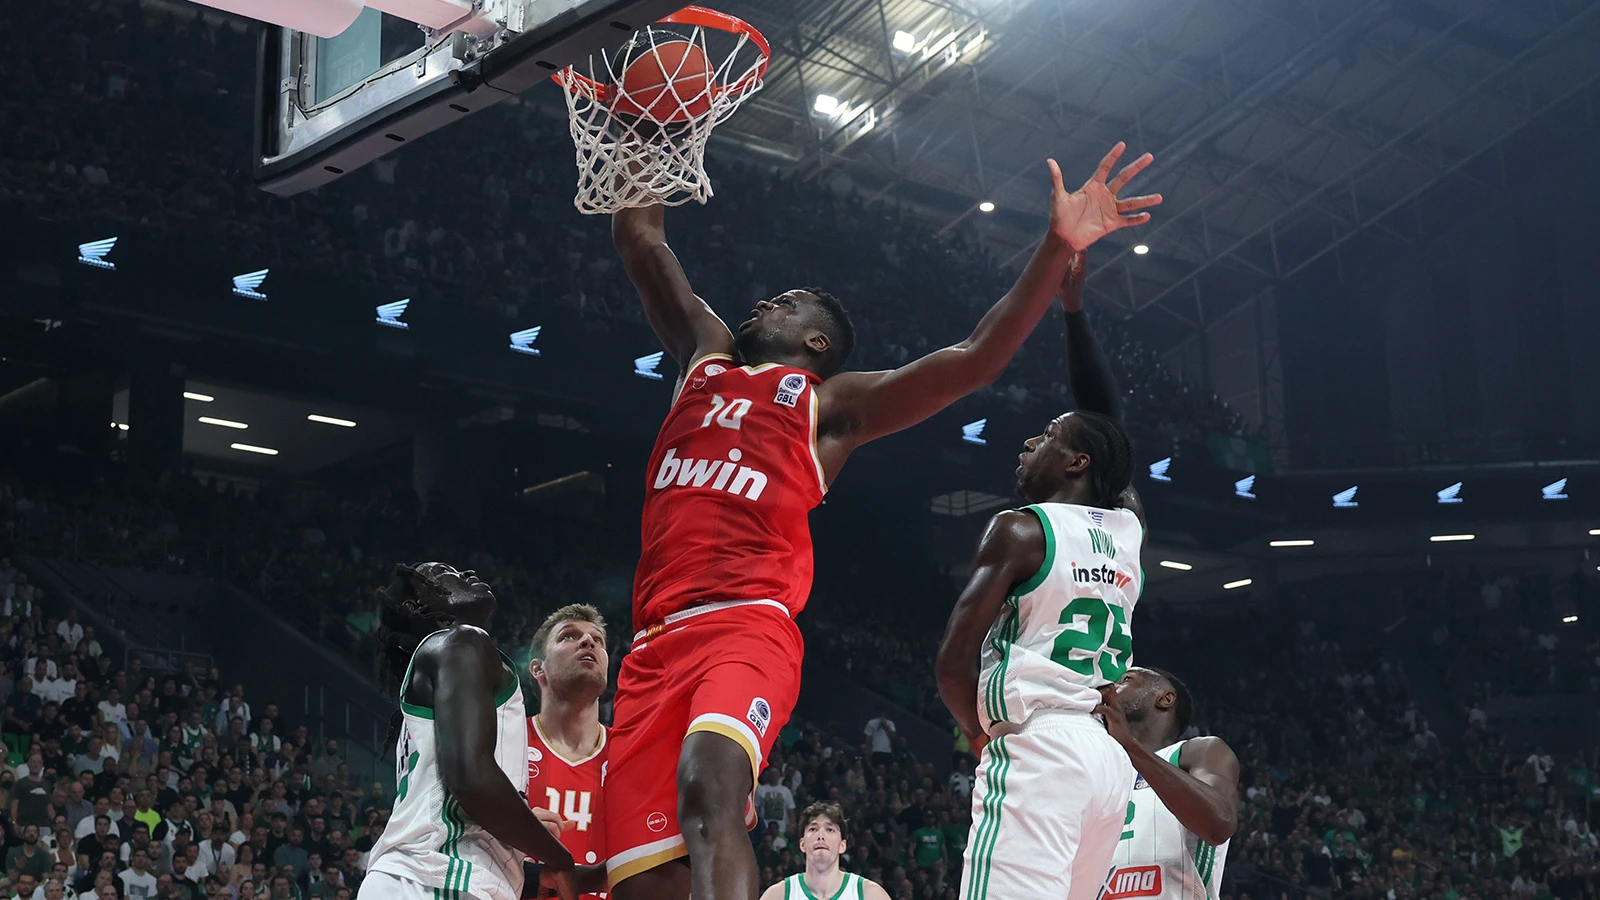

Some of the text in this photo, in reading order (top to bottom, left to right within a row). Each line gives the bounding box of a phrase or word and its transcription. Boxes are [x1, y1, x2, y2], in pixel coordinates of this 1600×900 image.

[700, 393, 754, 430] 10
[776, 393, 794, 406] GBL
[653, 448, 768, 501] bwin
[1050, 597, 1133, 683] 25
[545, 786, 593, 832] 14
